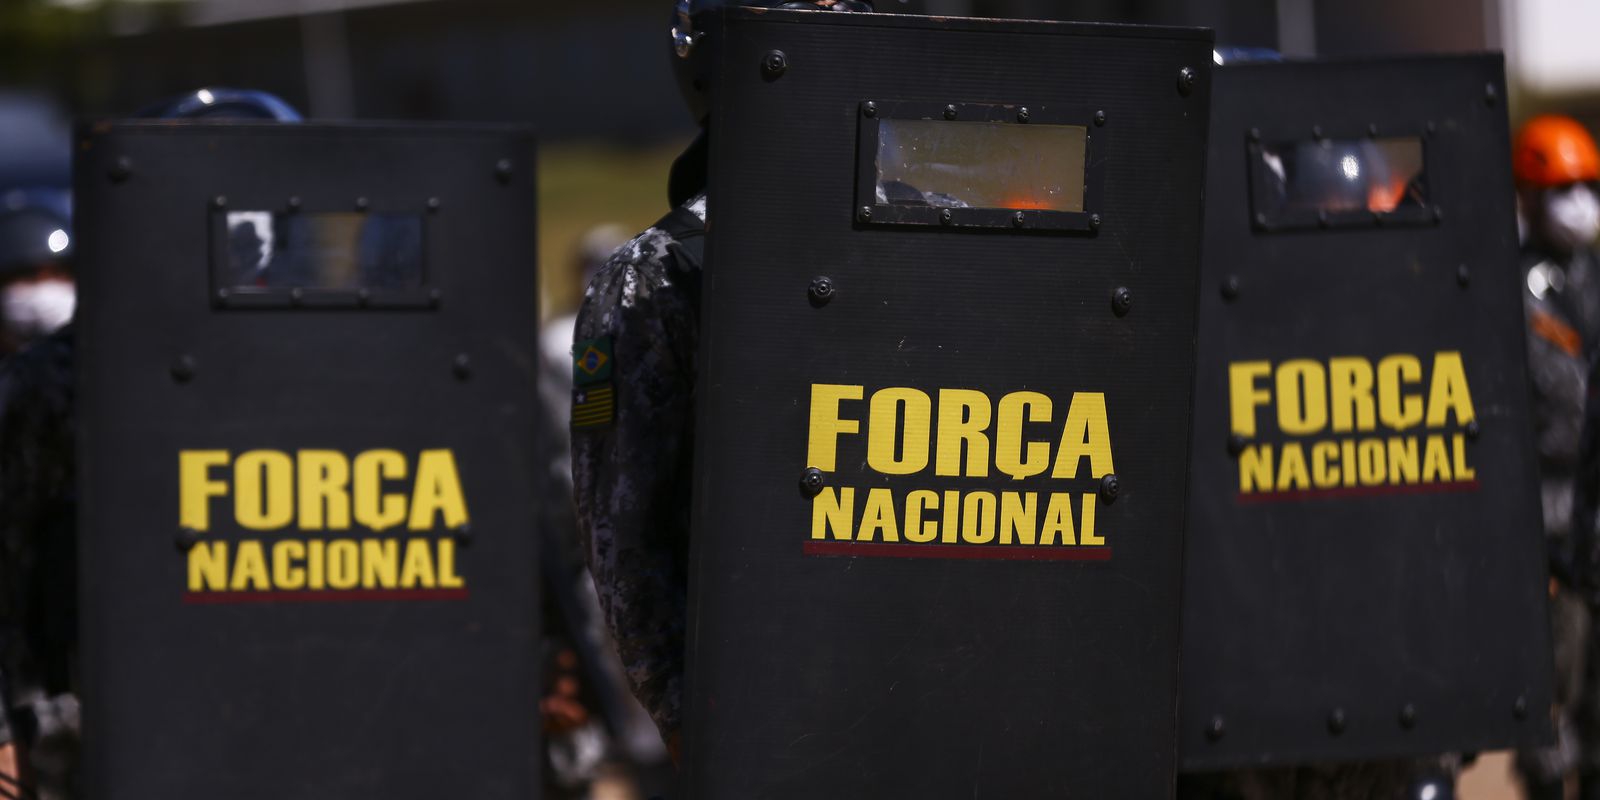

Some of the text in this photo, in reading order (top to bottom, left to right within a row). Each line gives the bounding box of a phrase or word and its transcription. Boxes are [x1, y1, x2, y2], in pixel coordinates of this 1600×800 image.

[1229, 351, 1475, 438] FORÇA
[806, 383, 1115, 481] FORÇA
[1239, 434, 1476, 493] NACIONAL
[179, 448, 469, 532] FORÇA
[811, 486, 1105, 546] NACIONAL
[188, 538, 464, 592] NACIONAL
